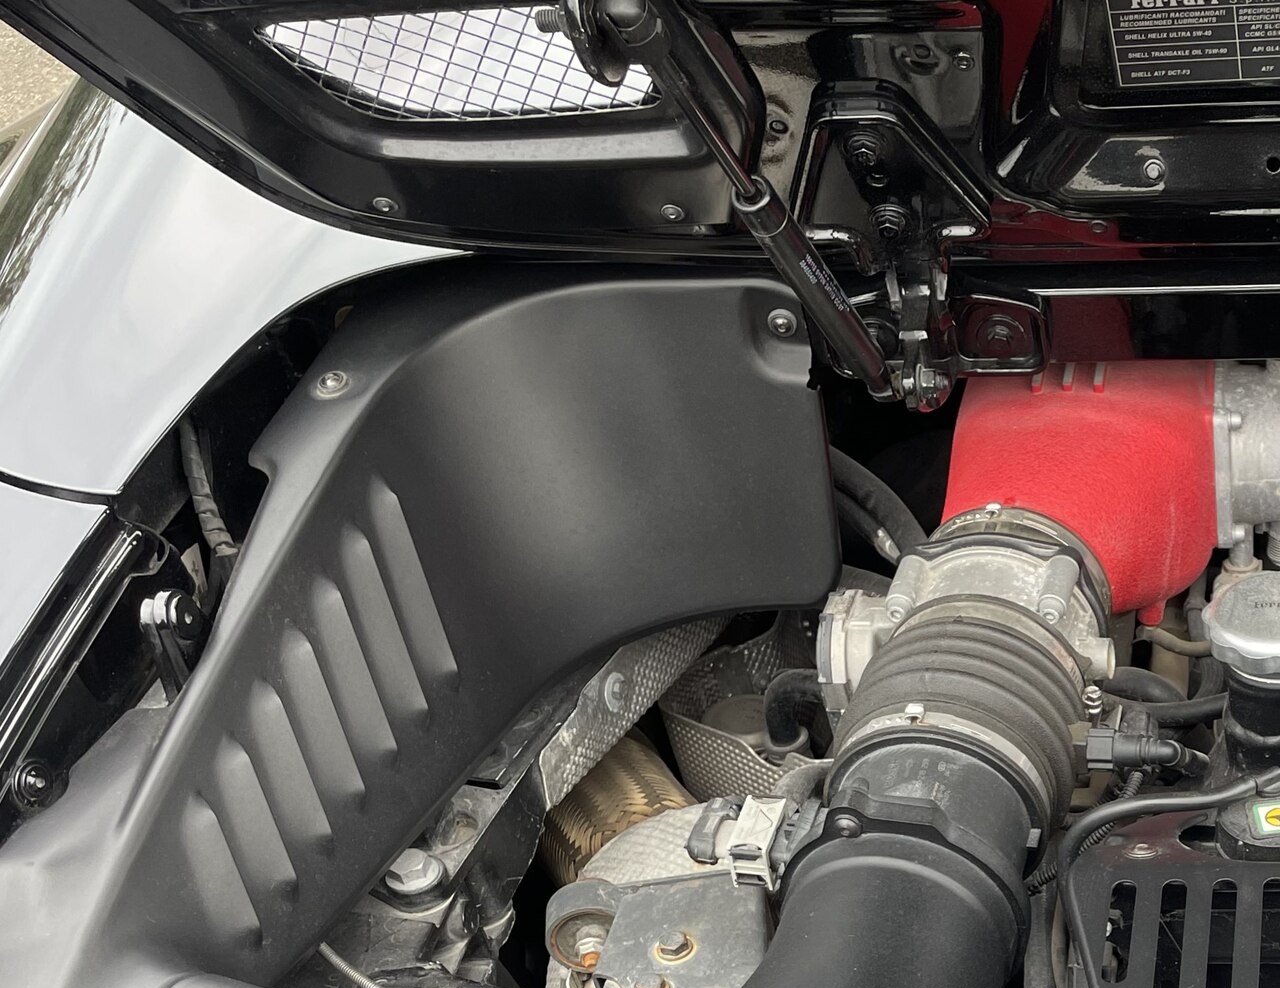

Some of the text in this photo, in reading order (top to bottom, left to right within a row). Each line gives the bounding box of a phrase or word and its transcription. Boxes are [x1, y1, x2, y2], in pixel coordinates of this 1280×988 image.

[1120, 10, 1226, 21] LUBRIFICANTI RACCOMANDATI
[1174, 17, 1217, 25] LUBRICANTS
[1151, 49, 1190, 57] TRANSAXLE
